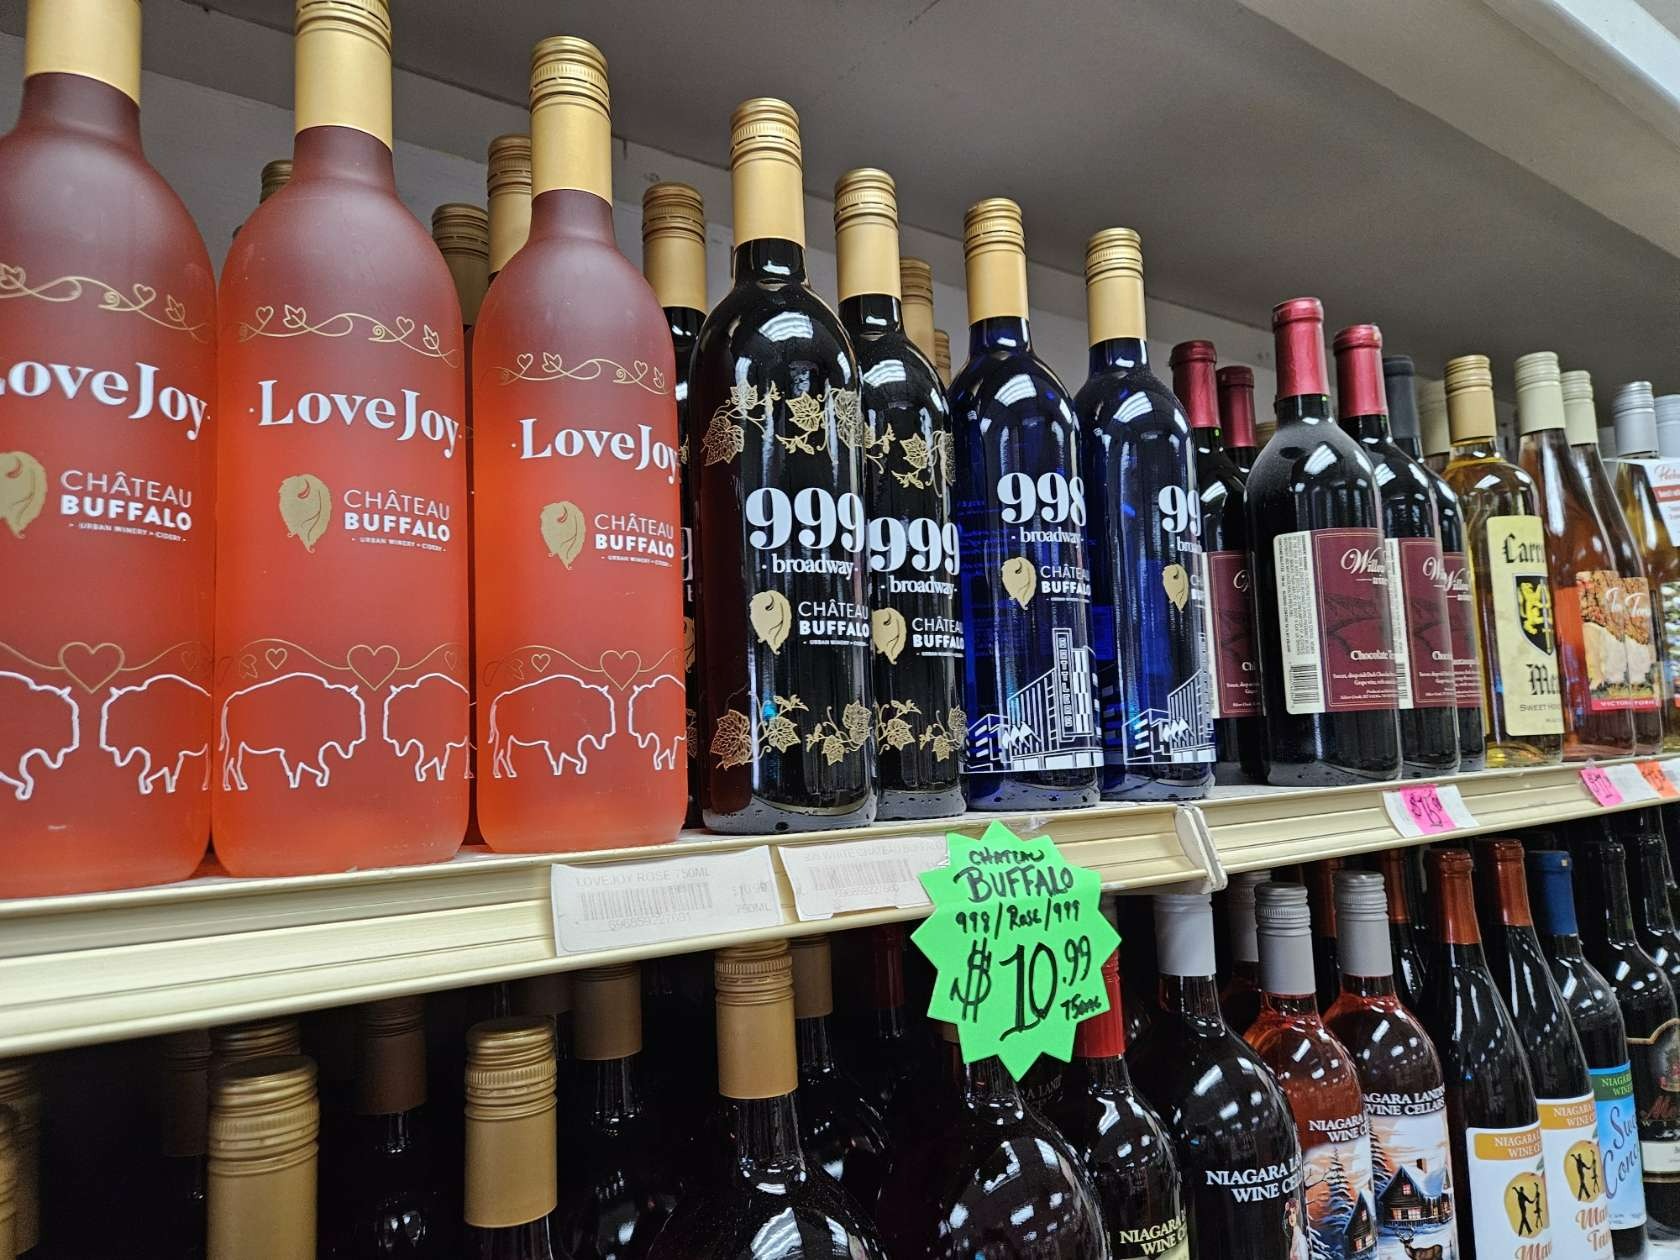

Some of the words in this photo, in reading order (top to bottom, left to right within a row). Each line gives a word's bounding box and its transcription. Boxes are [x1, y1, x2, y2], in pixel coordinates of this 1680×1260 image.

[258, 379, 459, 458] LoveJoy
[520, 418, 678, 484] LoveJoy
[60, 470, 192, 508] CHÂTEAU
[997, 472, 1087, 527] 998
[61, 494, 192, 530] BUFFALO
[344, 489, 449, 521] CHÂTEAU
[1158, 485, 1201, 536] 99
[344, 512, 450, 542] BUFFALO
[594, 512, 674, 540] CHÂTEAU
[746, 487, 865, 552] 999
[595, 533, 675, 558] BUFFALO
[868, 517, 960, 576] 999
[1020, 526, 1081, 549] broadway
[771, 553, 854, 580] broadway
[888, 575, 954, 600] broadway
[798, 599, 869, 620] CHÂTEAU
[799, 620, 870, 638] BUFFALO
[576, 874, 632, 887] LOVEJOY
[636, 871, 670, 883] ROSE
[953, 864, 1075, 903] BUFFALO
[1309, 1113, 1363, 1132] NIAGARA
[1327, 1128, 1359, 1142] WINE
[1494, 1132, 1537, 1147] NIAGARA
[1508, 1144, 1532, 1158] WINE
[1206, 1163, 1286, 1185] NIAGARA
[1232, 1182, 1280, 1203] WINE
[1120, 1215, 1182, 1244] NIAGARA
[1141, 1235, 1176, 1255] WINE
